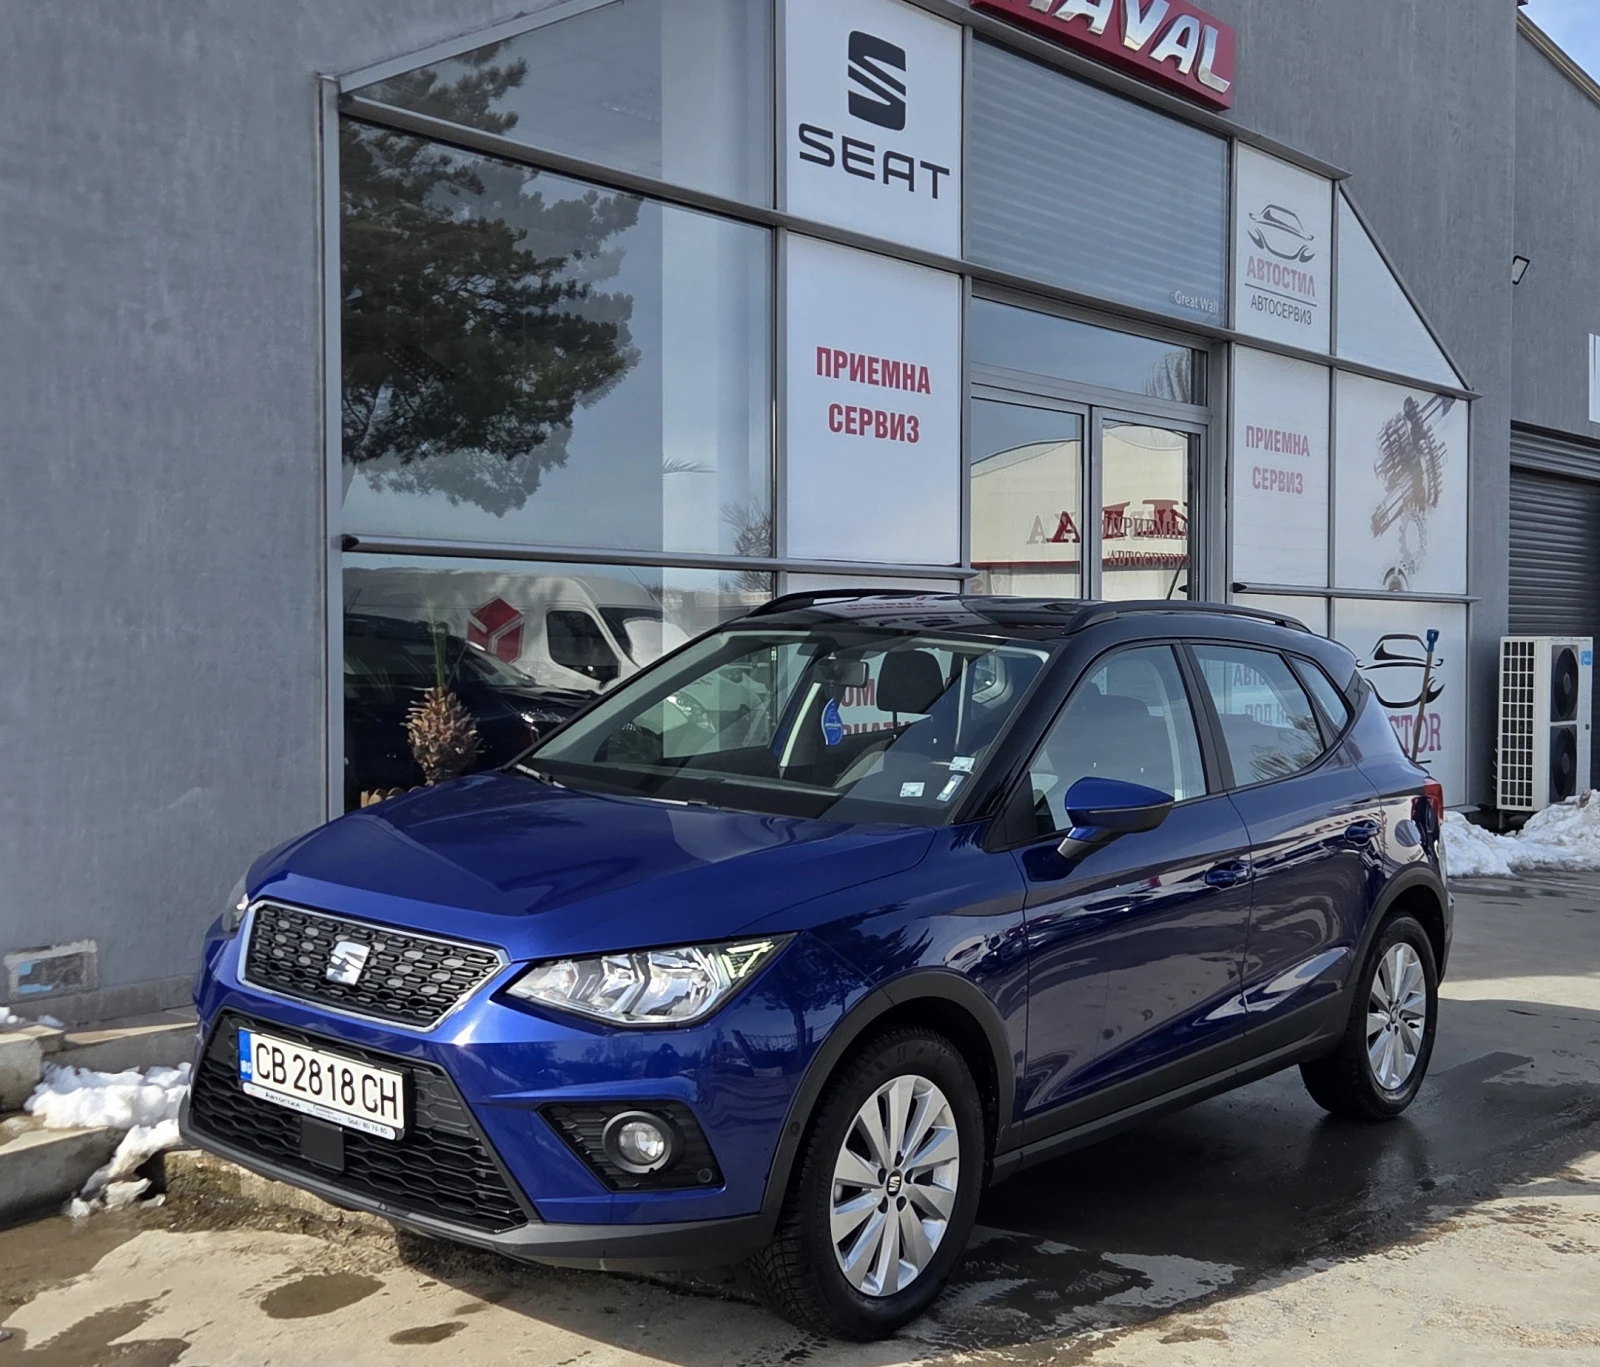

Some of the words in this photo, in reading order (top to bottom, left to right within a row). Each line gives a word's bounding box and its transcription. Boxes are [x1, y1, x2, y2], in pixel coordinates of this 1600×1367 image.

[1028, 0, 1231, 94] AVAL
[799, 123, 950, 199] SEAT
[1246, 255, 1316, 297] АВТОСТИЛ
[1174, 290, 1198, 309] Great
[1199, 296, 1219, 313] Wall
[1250, 294, 1312, 325] АВТОСЕРВИЗ
[816, 346, 931, 395] ПРИЕМНА
[828, 403, 920, 444] СЕРВИЗ
[1246, 425, 1310, 457] ПРИЕМНА
[1252, 466, 1304, 495] СЕРВИЗ
